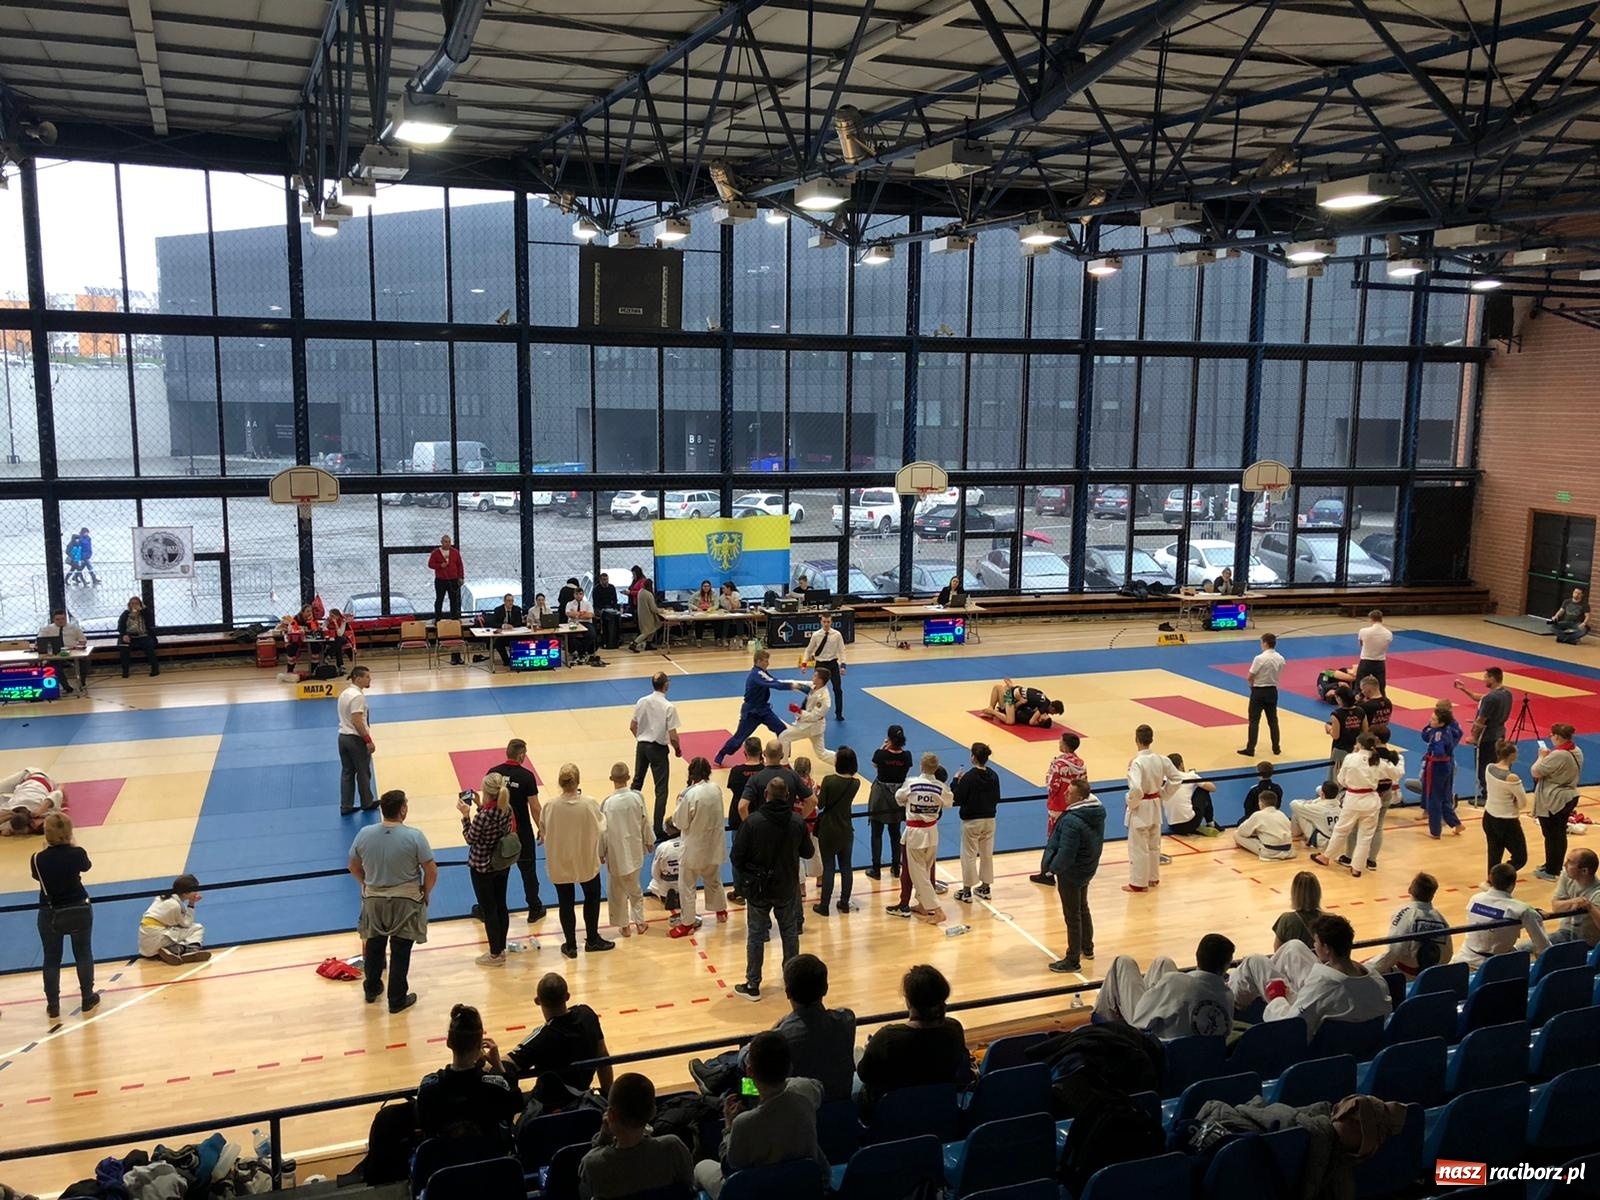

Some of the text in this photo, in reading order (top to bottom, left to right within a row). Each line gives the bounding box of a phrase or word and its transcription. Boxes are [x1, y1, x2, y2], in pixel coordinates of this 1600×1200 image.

[955, 618, 964, 626] 2
[954, 626, 964, 635] 0
[1179, 633, 1185, 642] 4
[549, 640, 560, 648] 2
[550, 648, 560, 658] 5
[524, 658, 548, 668] 1:56
[42, 666, 56, 678] 2
[43, 678, 56, 688] 0
[11, 688, 42, 698] 2:27
[304, 684, 333, 696] MATA 2
[917, 794, 934, 802] POL
[1326, 816, 1339, 826] PO
